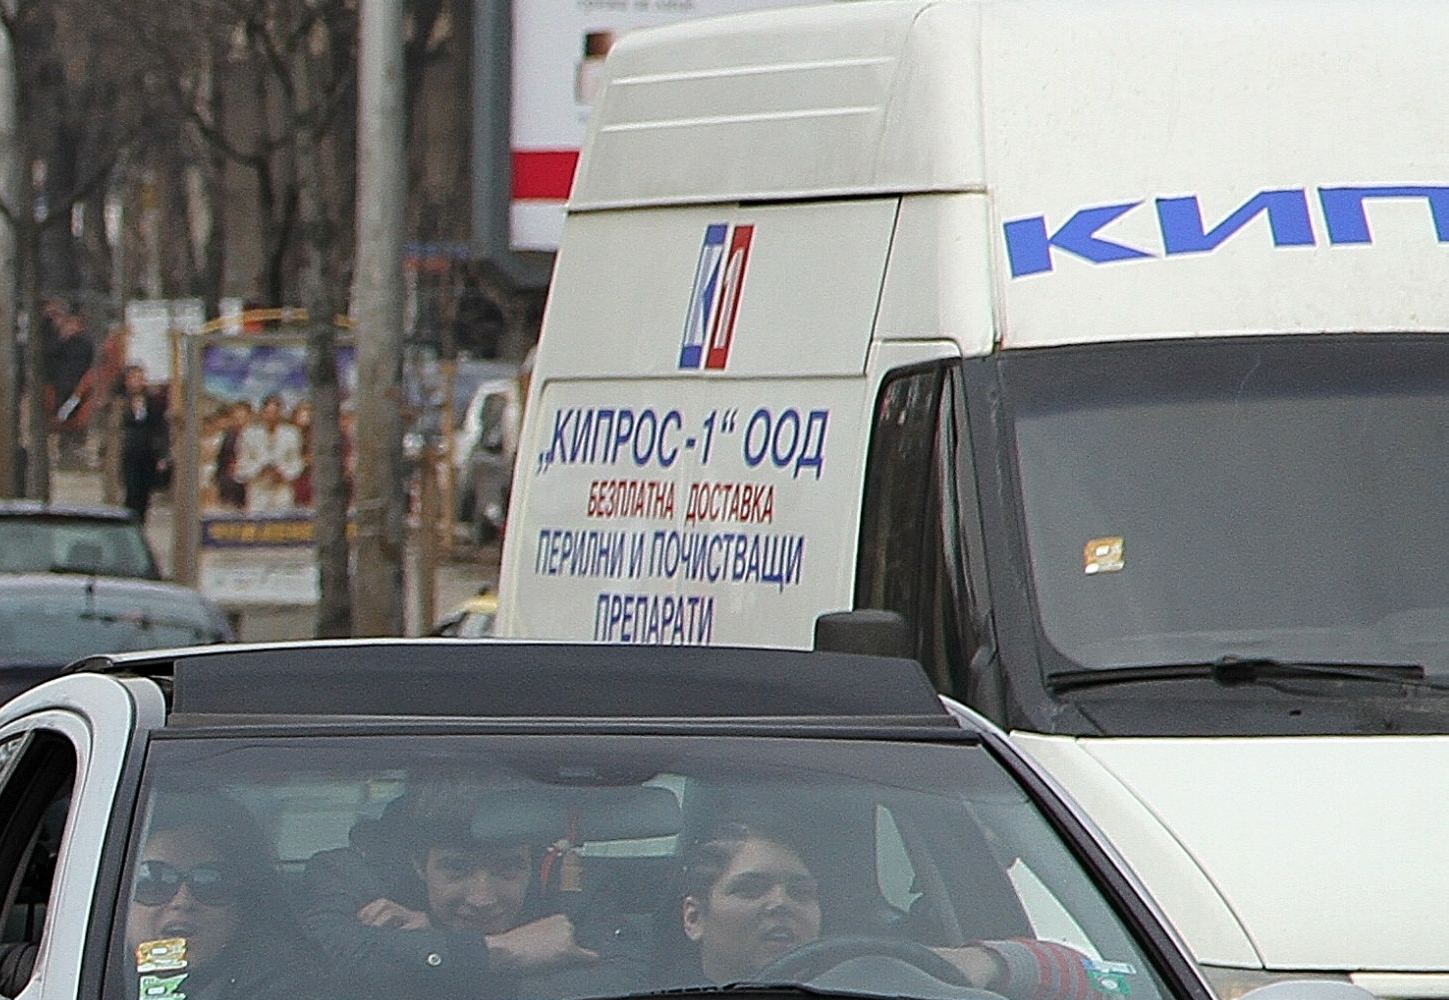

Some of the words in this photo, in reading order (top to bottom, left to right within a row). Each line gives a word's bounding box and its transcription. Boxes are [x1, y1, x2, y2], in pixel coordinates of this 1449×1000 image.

[743, 407, 830, 480] ООД
[587, 480, 675, 520] БЕЗПЛАТНА
[685, 482, 775, 527] ДОСТАВКА
[535, 530, 626, 578] ПЕРИЛНИ
[628, 533, 645, 579] И
[648, 531, 805, 593] ПОЧИСТВАЩИ
[594, 594, 715, 645] ПРЕПАРАТИ
